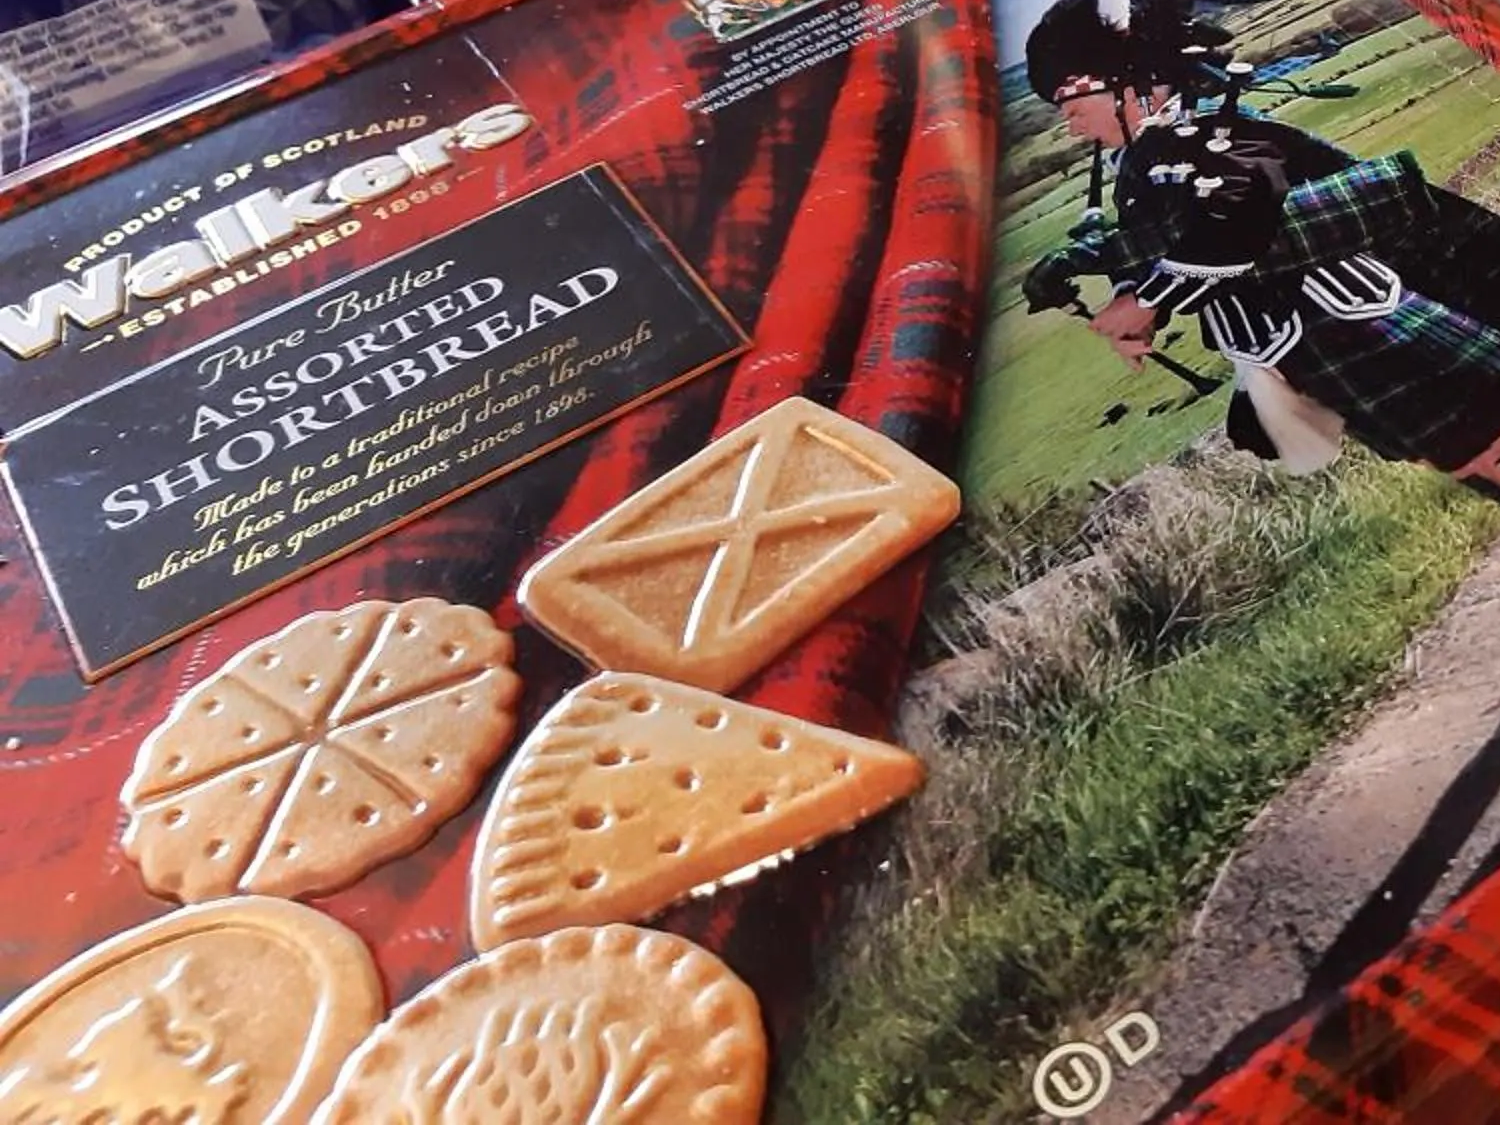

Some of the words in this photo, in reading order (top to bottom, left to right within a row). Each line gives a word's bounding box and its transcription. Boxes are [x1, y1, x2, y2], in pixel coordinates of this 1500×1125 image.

[682, 66, 771, 110] SHORTBREAD
[781, 33, 842, 65] OATCAKE
[700, 82, 765, 115] WALKERS
[763, 42, 850, 87] SHORTBREAD
[724, 61, 752, 78] HER
[751, 34, 812, 65] MAJESTY
[811, 21, 841, 38] THE
[731, 48, 748, 63] BY
[750, 9, 840, 54] APPOINTMENT
[840, 1, 861, 12] TO
[63, 185, 202, 273] PRODUCT
[213, 162, 254, 192] OF
[262, 114, 429, 170] SCOTLAND
[118, 219, 363, 339] ESTABLISHED
[371, 180, 450, 221] 1898
[101, 266, 620, 531] SHORTBREAD
[187, 276, 505, 444] ASSORTED
[197, 328, 306, 390] Pure
[314, 260, 456, 335] Butter
[136, 527, 228, 591] which
[233, 507, 287, 545] has
[291, 474, 359, 515] been
[364, 408, 471, 480] handed
[474, 384, 542, 424] down
[548, 319, 654, 389] through
[193, 475, 285, 532] Made
[289, 464, 317, 487] to
[321, 450, 343, 470] a
[346, 367, 495, 459] traditional
[499, 335, 580, 384] recipe
[230, 540, 281, 577] the
[285, 457, 452, 559] generations
[456, 421, 525, 464] since
